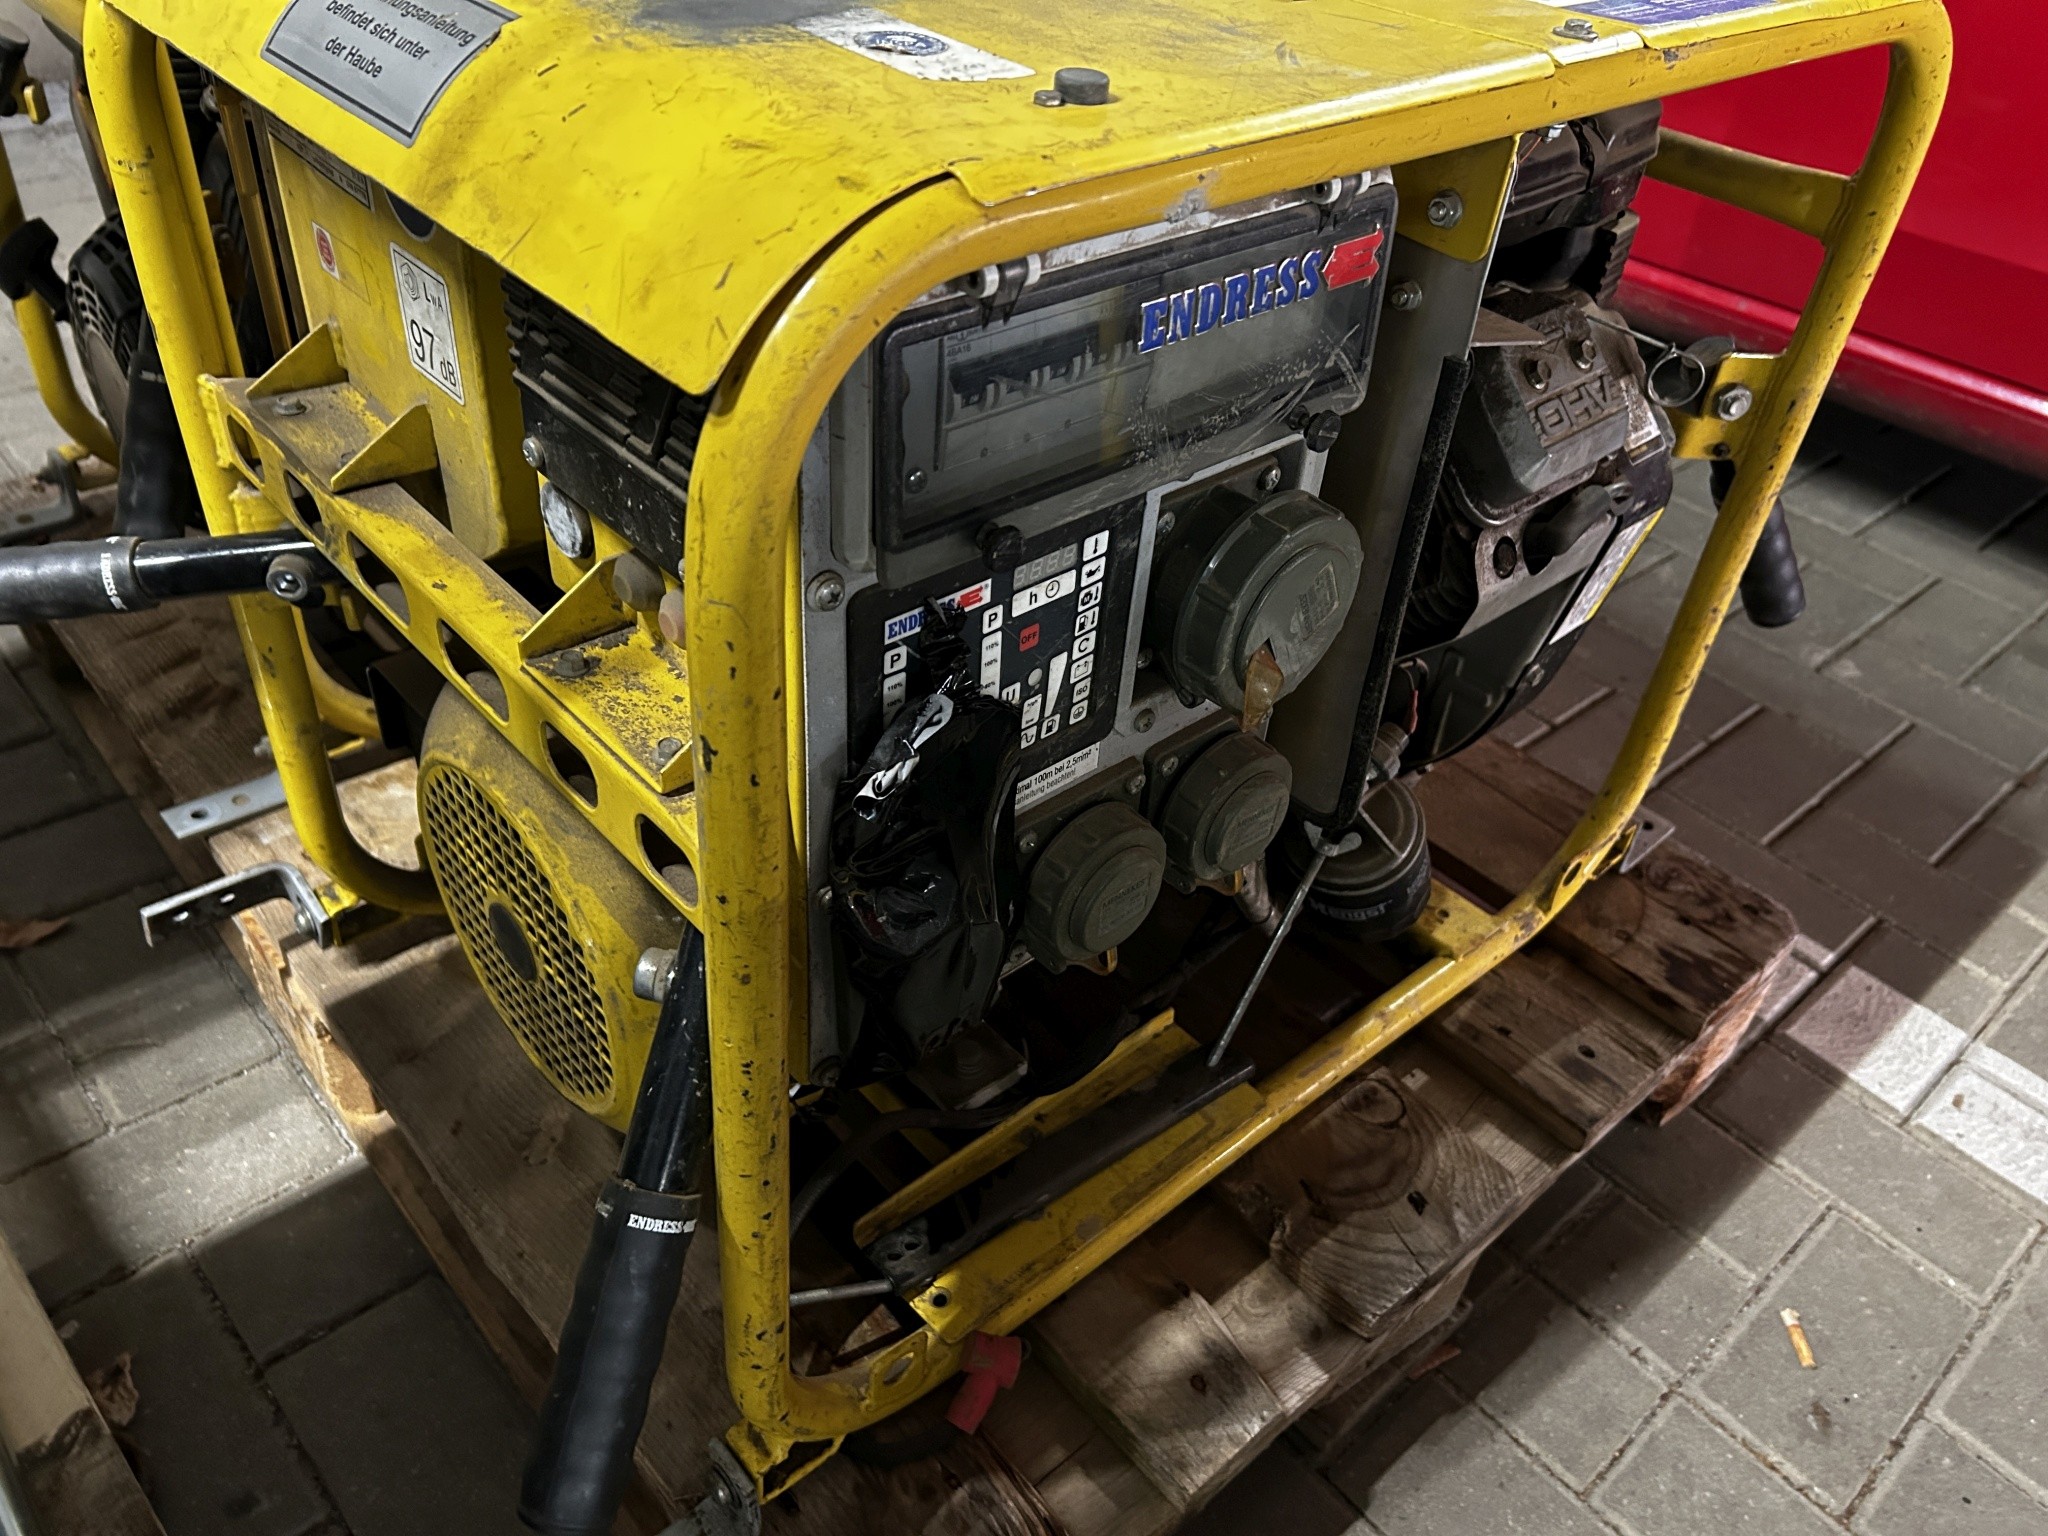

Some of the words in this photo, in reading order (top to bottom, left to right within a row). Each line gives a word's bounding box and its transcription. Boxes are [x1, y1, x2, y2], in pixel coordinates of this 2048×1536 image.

[326, 0, 374, 31] befindet
[369, 22, 397, 44] sich
[394, 33, 429, 61] unter
[325, 36, 347, 57] der
[343, 45, 383, 79] Haube
[1138, 249, 1322, 355] ENDRESS
[410, 319, 435, 371] 97
[439, 356, 457, 387] dB
[1029, 591, 1038, 606] h
[988, 612, 998, 628] P
[985, 641, 999, 652] 110%
[1021, 632, 1038, 645] OFF
[1078, 637, 1090, 653] C
[890, 653, 902, 669] P
[984, 658, 998, 668] 100%
[887, 682, 903, 692] 110%
[1076, 684, 1088, 697] ISO
[1034, 769, 1053, 786] 100m
[1054, 764, 1065, 778] bei
[1046, 767, 1076, 790] beachten!
[627, 1213, 683, 1234] ENDRESS
